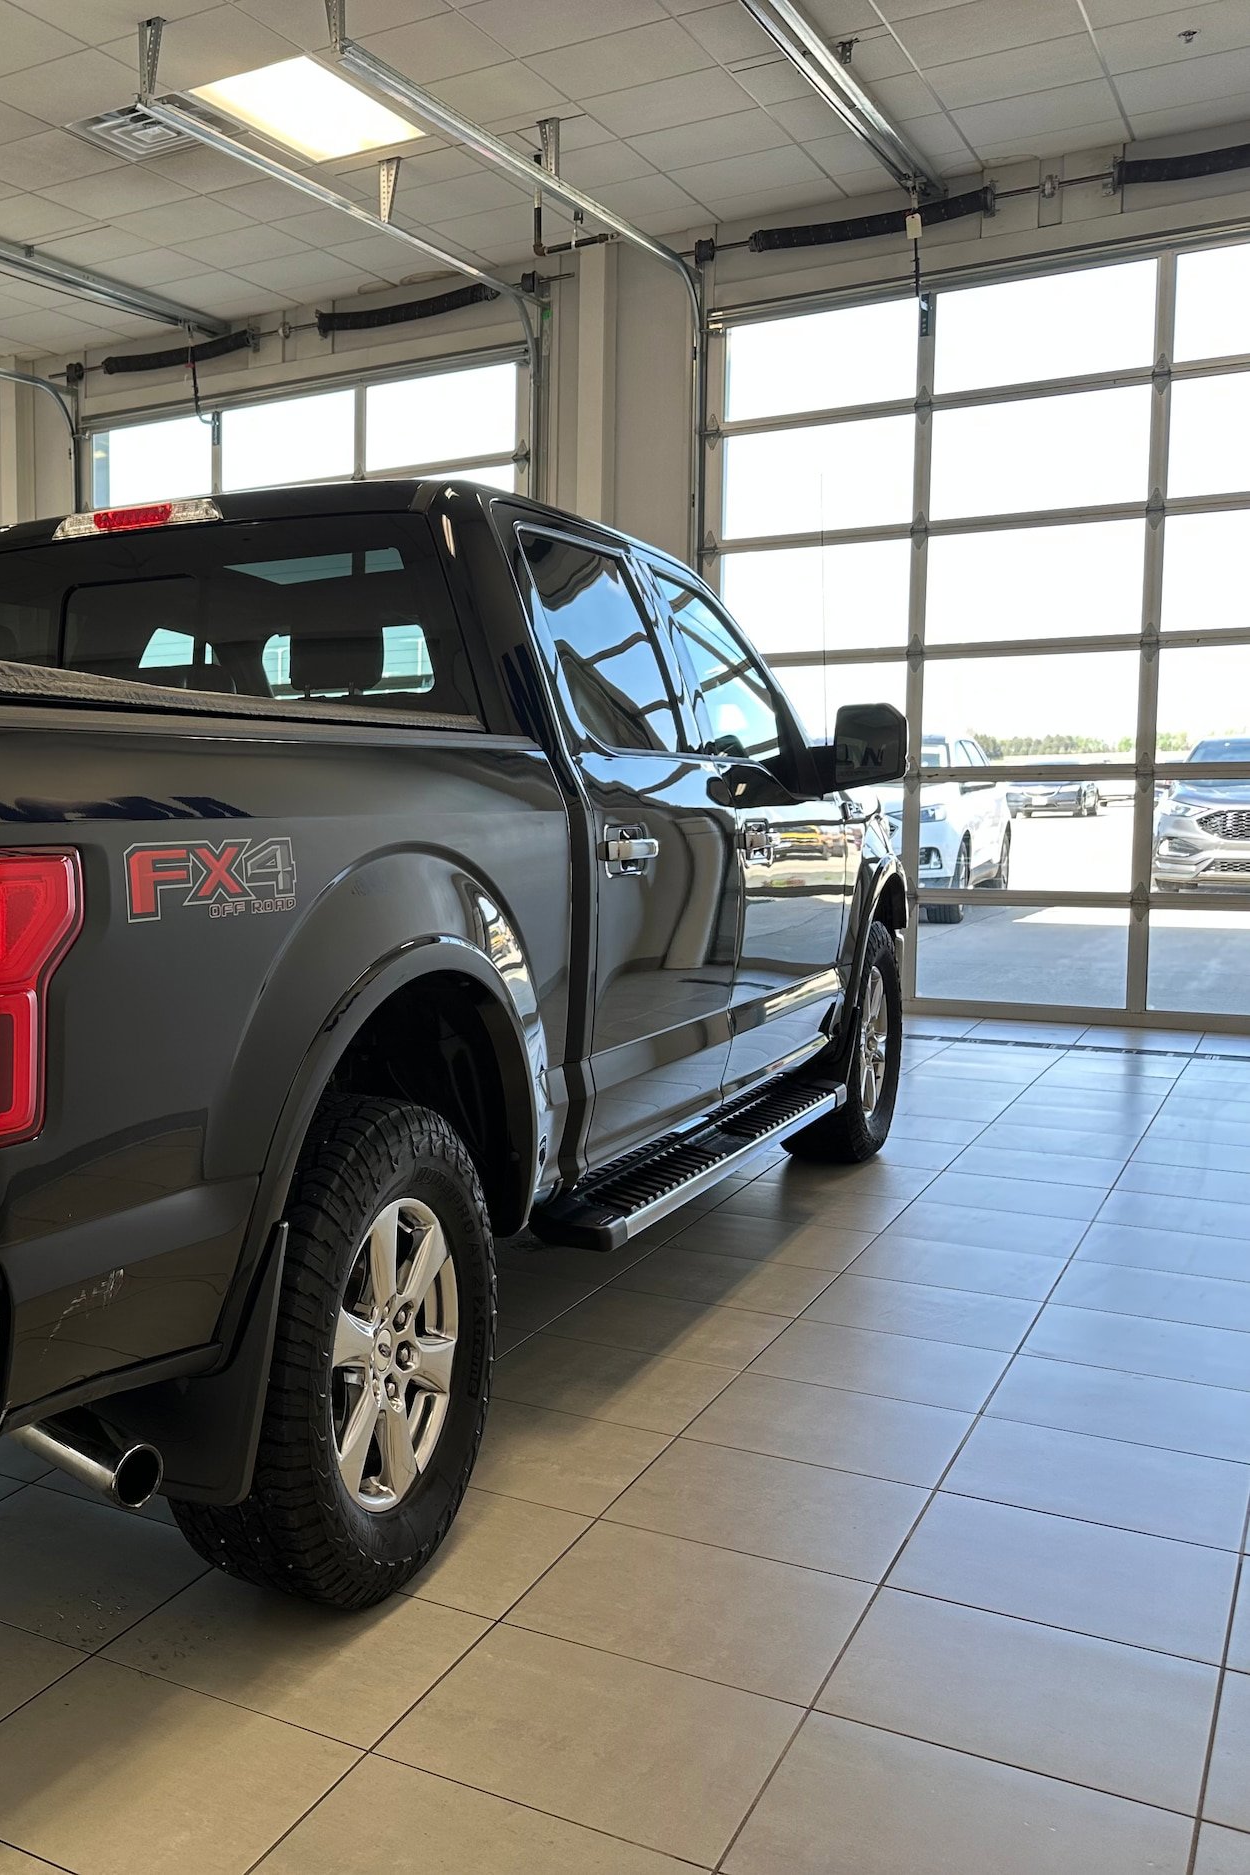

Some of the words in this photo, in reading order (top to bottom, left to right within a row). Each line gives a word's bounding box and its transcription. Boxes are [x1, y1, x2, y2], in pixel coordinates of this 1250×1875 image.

[124, 837, 297, 923] FX4
[209, 901, 246, 919] OFF
[251, 897, 297, 915] ROAD
